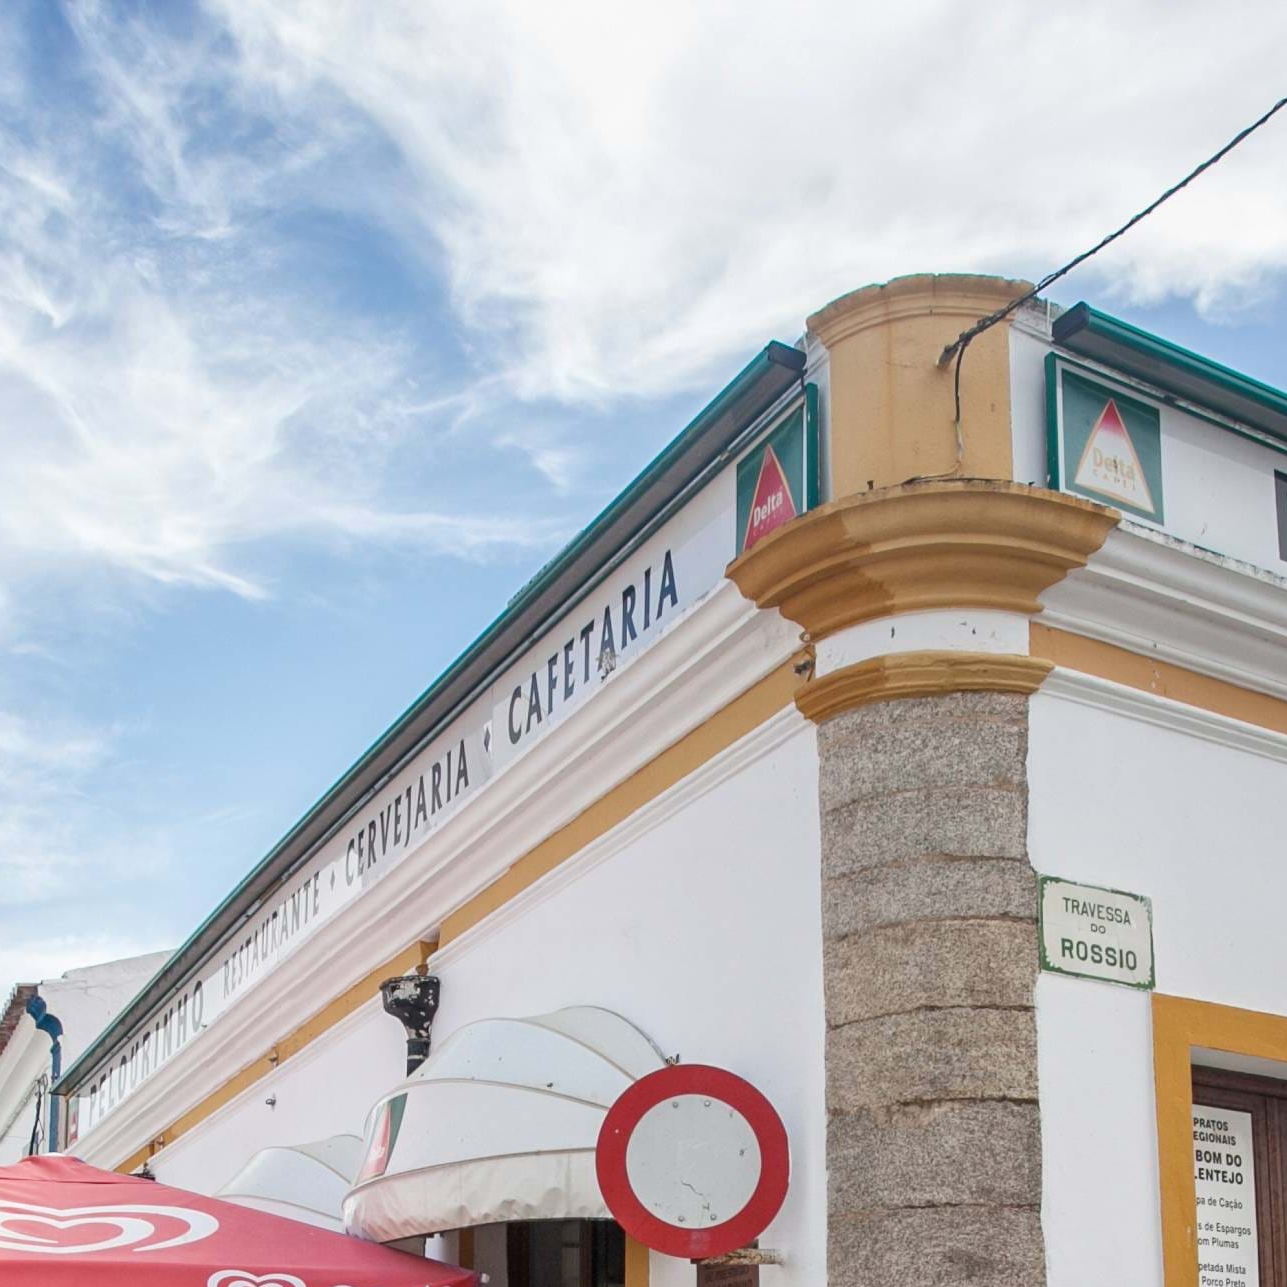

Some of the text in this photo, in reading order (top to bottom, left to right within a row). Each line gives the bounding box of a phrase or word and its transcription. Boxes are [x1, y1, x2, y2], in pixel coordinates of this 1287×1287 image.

[753, 491, 783, 528] Delta
[89, 549, 679, 1129] PELOURINHO RESTAURANTE CERVEJARIA CAFETARIA
[1062, 897, 1131, 925] TRAVESSA
[1090, 923, 1106, 934] DO
[1061, 938, 1137, 971] ROSSIO
[1193, 1117, 1229, 1131] PRATOS
[1192, 1131, 1236, 1146] EGIONAIS
[1195, 1150, 1242, 1167] BOM DO
[1216, 1223, 1251, 1236] Espargos
[1212, 1238, 1239, 1249] Plumas
[1226, 1263, 1246, 1275] Mista
[1202, 1276, 1224, 1287] Porco
